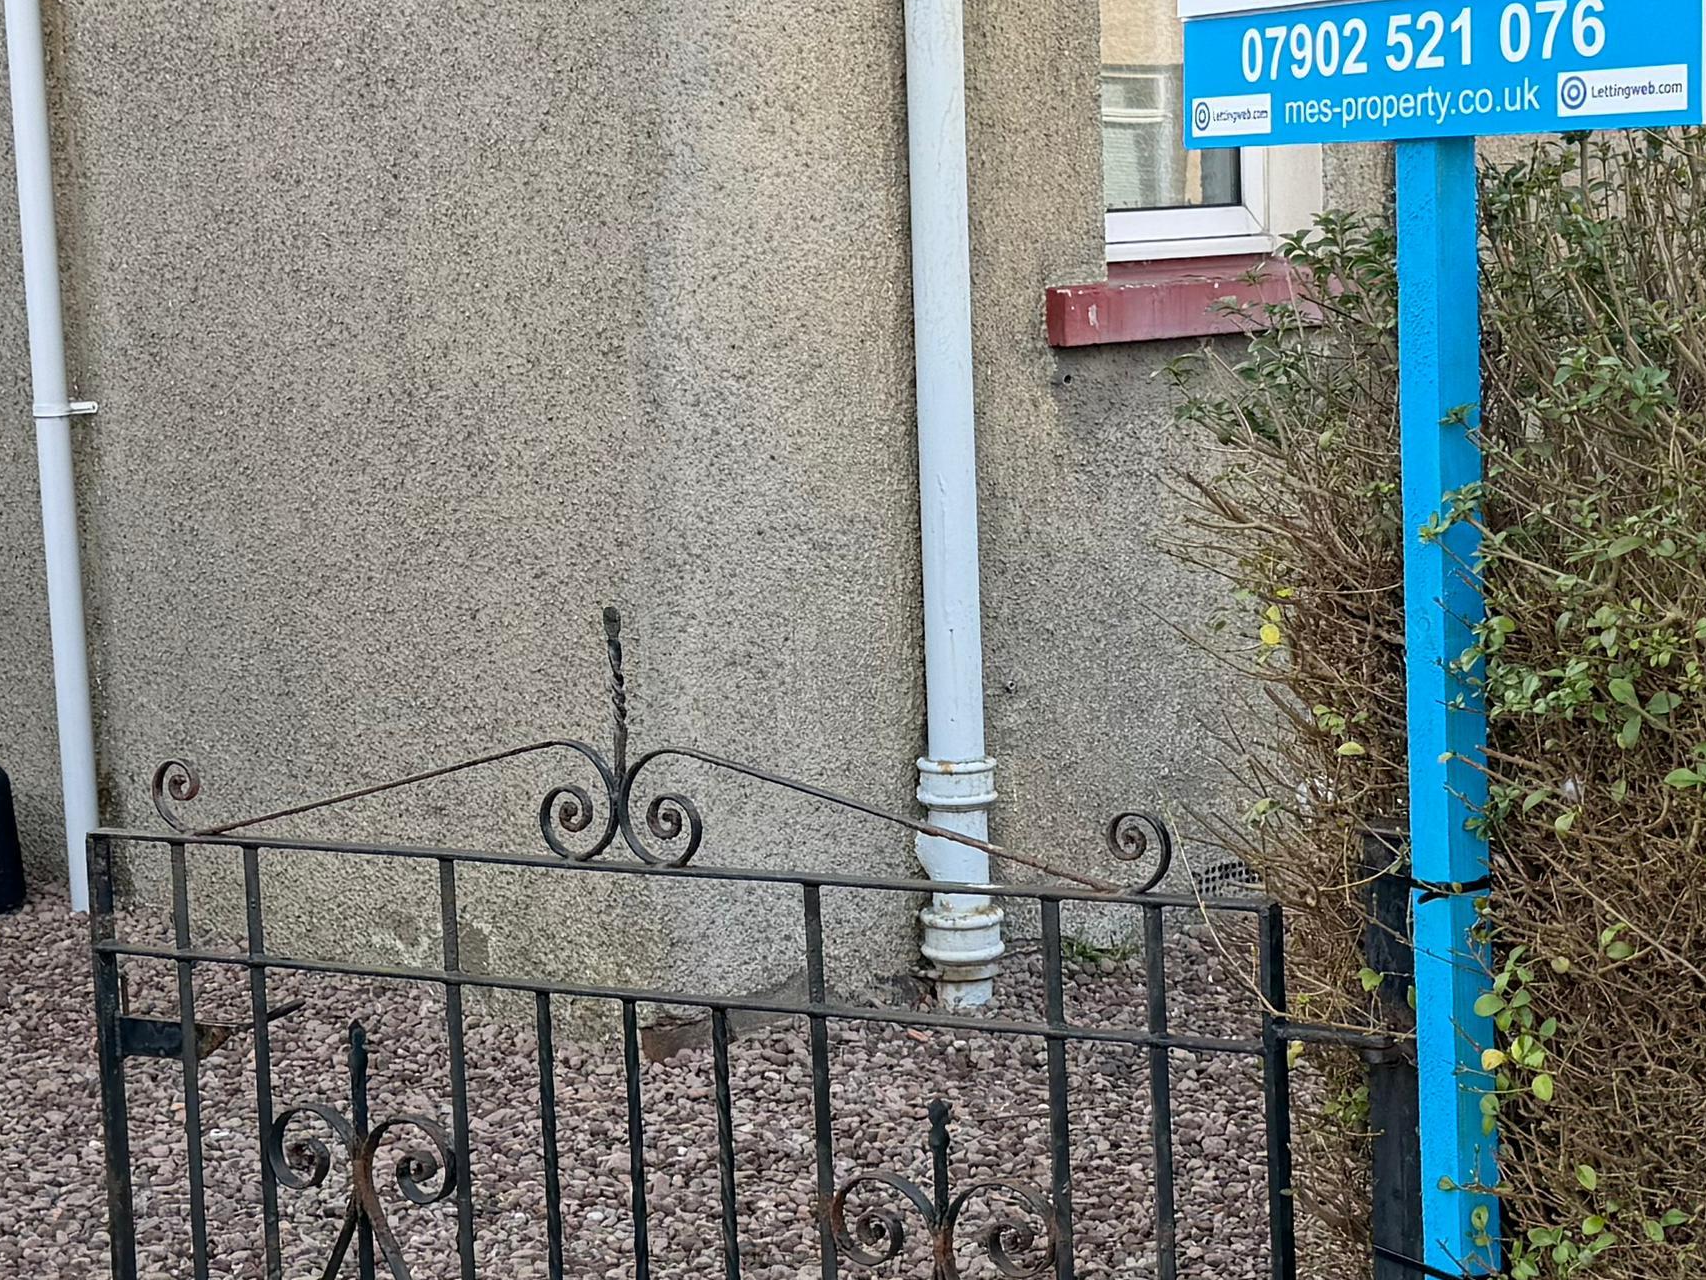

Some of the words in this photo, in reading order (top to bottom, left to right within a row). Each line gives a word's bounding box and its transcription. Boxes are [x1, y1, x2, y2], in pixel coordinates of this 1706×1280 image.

[1242, 17, 1369, 83] 07902
[1384, 6, 1473, 72] 521
[1284, 76, 1541, 128] mes-property.co.uk
[1591, 80, 1683, 100] Lettingweb.com
